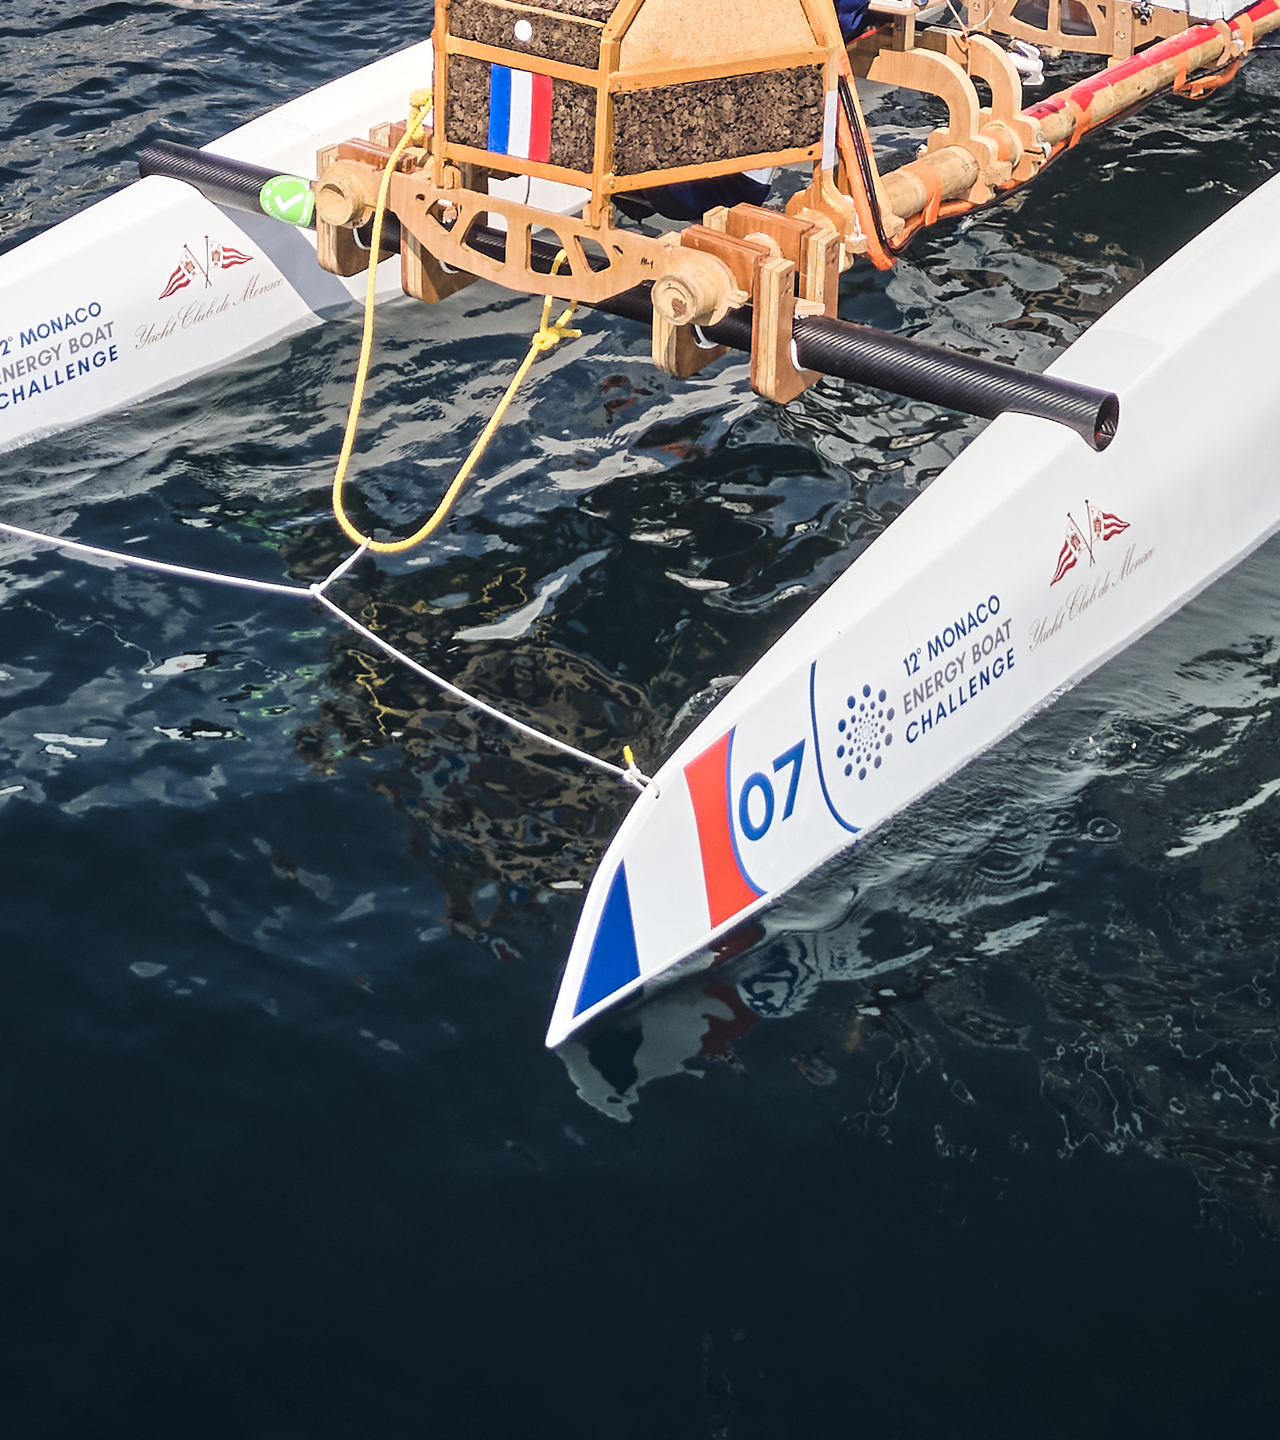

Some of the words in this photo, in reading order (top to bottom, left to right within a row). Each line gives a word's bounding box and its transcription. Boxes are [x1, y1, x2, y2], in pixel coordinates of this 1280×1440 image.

[19, 302, 102, 349] MONACO
[68, 321, 115, 355] BOAT
[134, 316, 177, 350] Yacht
[177, 296, 219, 330] Club
[216, 293, 230, 315] de
[232, 273, 284, 306] Monaco
[926, 594, 1000, 662] MONACO
[1029, 604, 1066, 652] Yacht
[1066, 575, 1101, 621] Club
[903, 651, 967, 715] ENERGY
[971, 618, 1013, 665] BOAT
[905, 647, 1015, 744] CHALLENGE
[738, 738, 806, 842] 07
